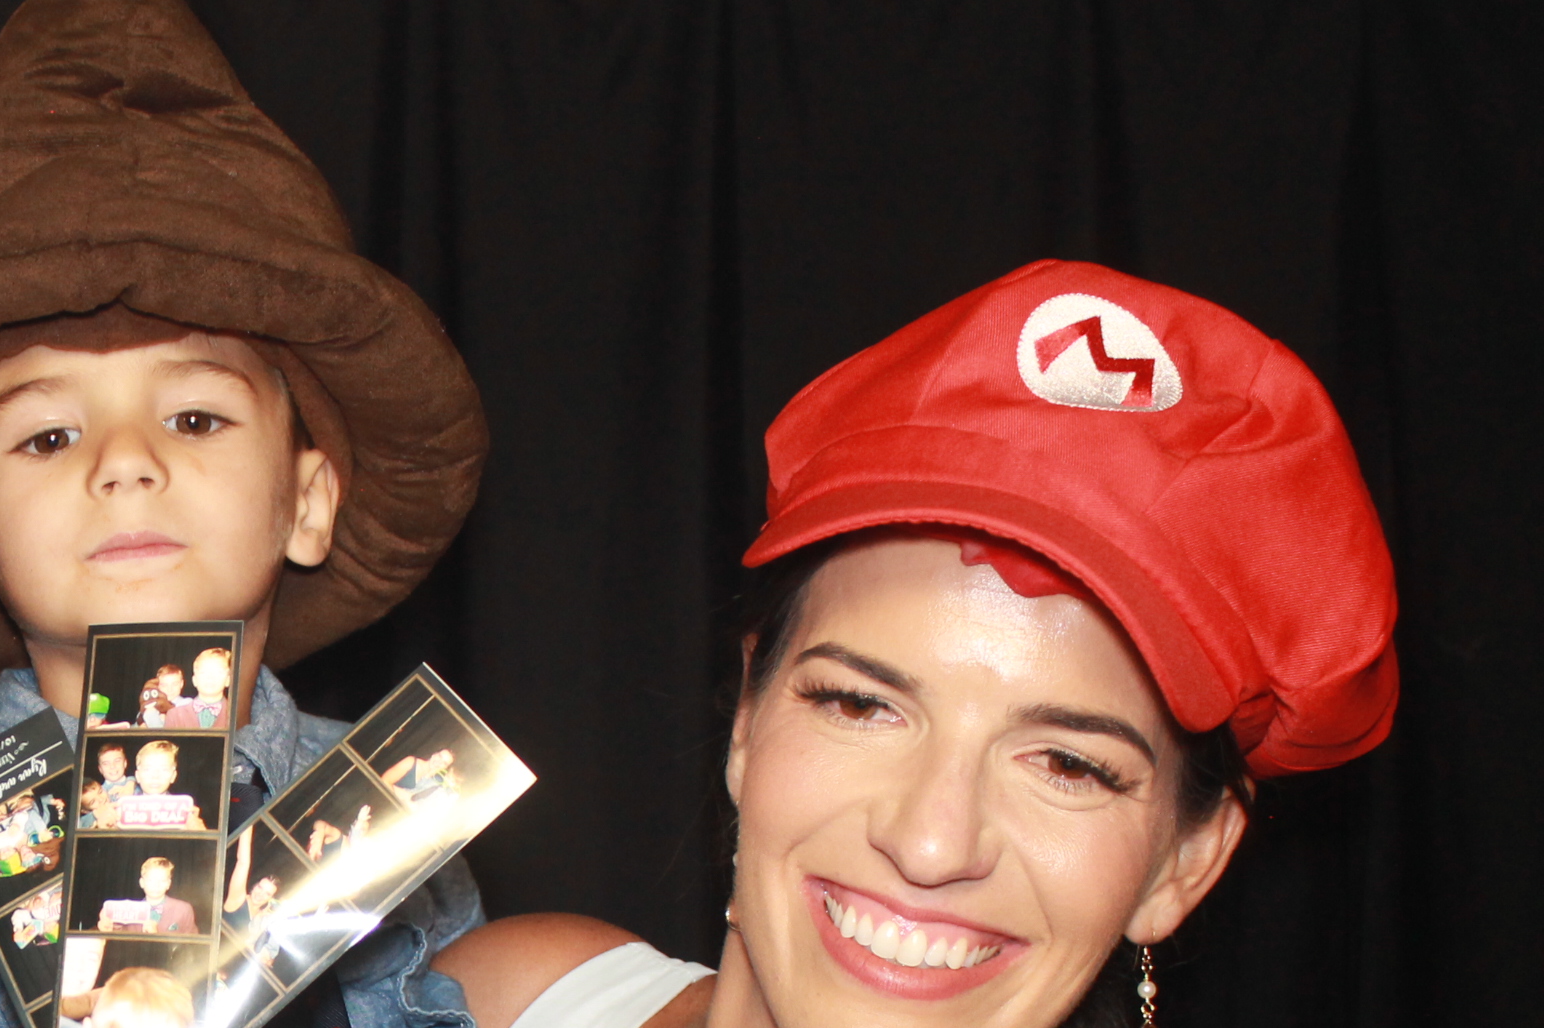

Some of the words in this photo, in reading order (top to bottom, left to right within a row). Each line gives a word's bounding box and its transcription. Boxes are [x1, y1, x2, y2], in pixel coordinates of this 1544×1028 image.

[1034, 315, 1156, 407] M
[18, 757, 47, 782] Ryan
[125, 810, 148, 823] BIG
[151, 810, 186, 823] DEAL
